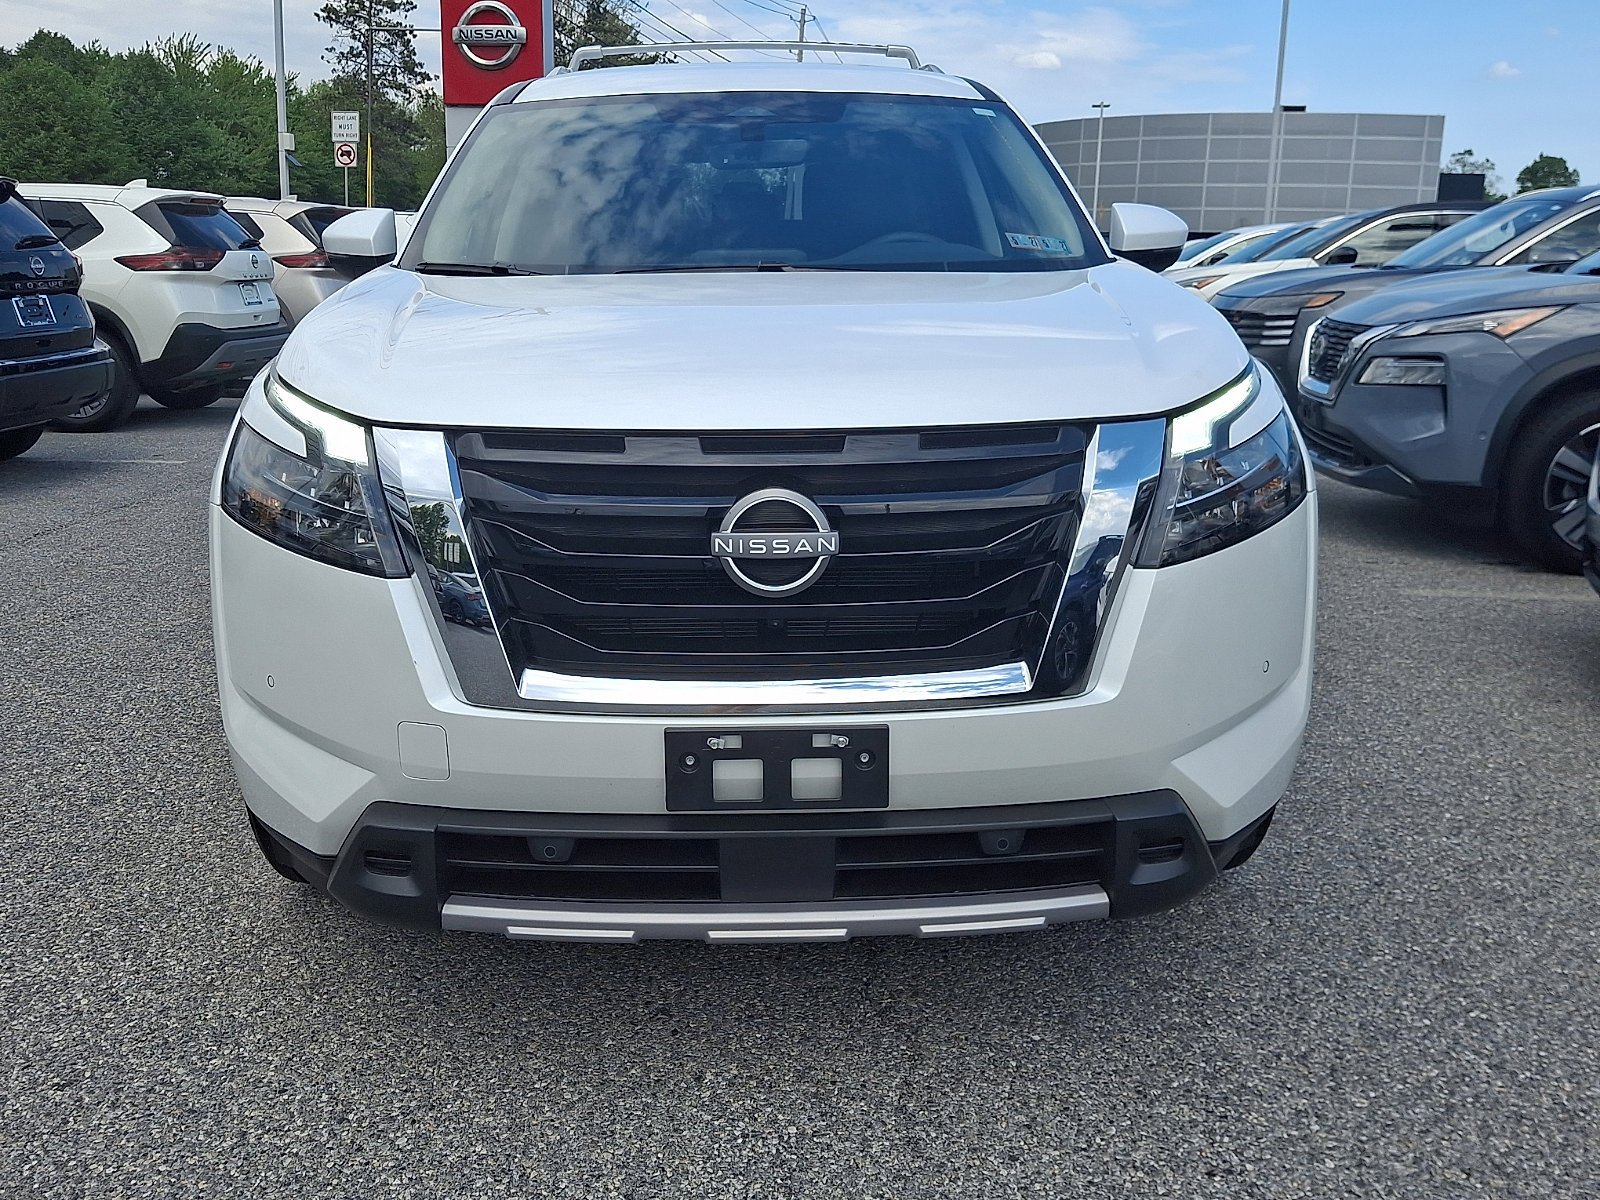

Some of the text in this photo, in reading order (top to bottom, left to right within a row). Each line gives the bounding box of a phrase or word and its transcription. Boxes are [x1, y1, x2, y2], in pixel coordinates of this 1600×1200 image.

[459, 29, 518, 40] NISSAN
[14, 280, 65, 290] ROGUE
[714, 536, 836, 554] NISSAN
